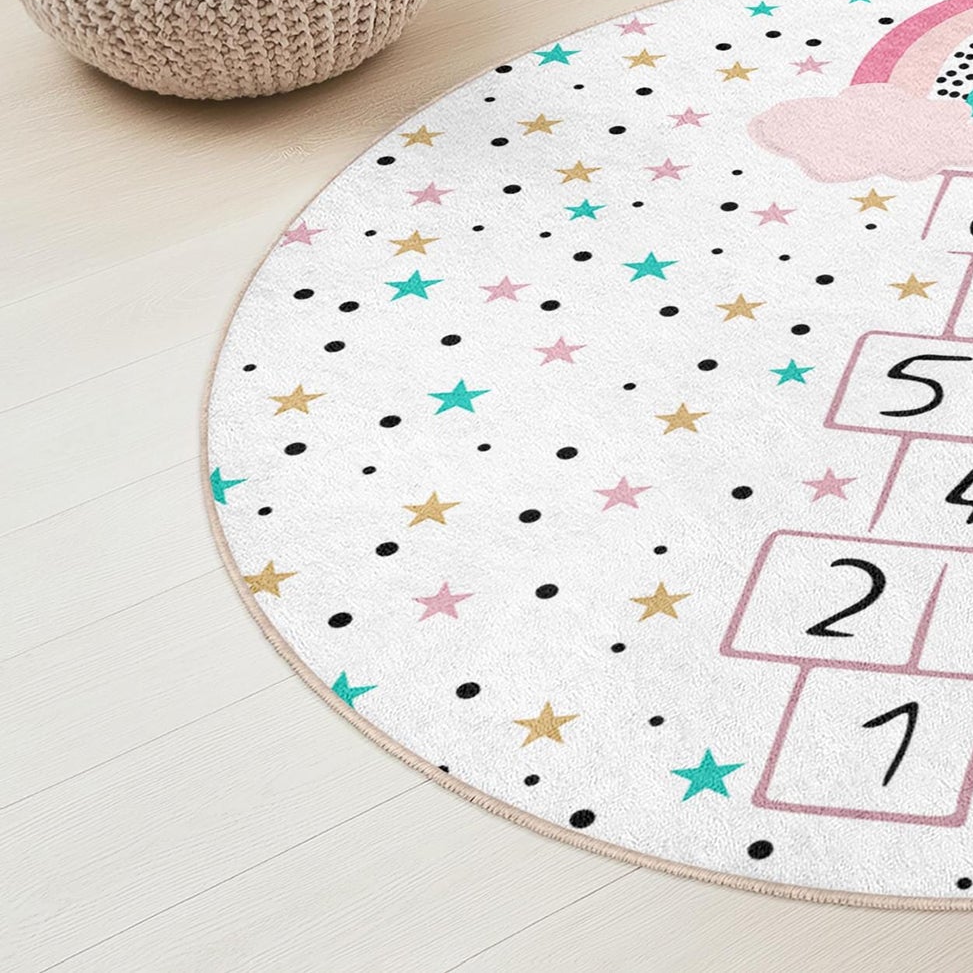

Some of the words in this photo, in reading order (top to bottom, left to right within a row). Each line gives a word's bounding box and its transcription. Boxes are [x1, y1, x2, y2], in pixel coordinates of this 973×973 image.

[879, 354, 973, 418] 5
[805, 558, 887, 638] 2
[862, 701, 919, 787] 1
